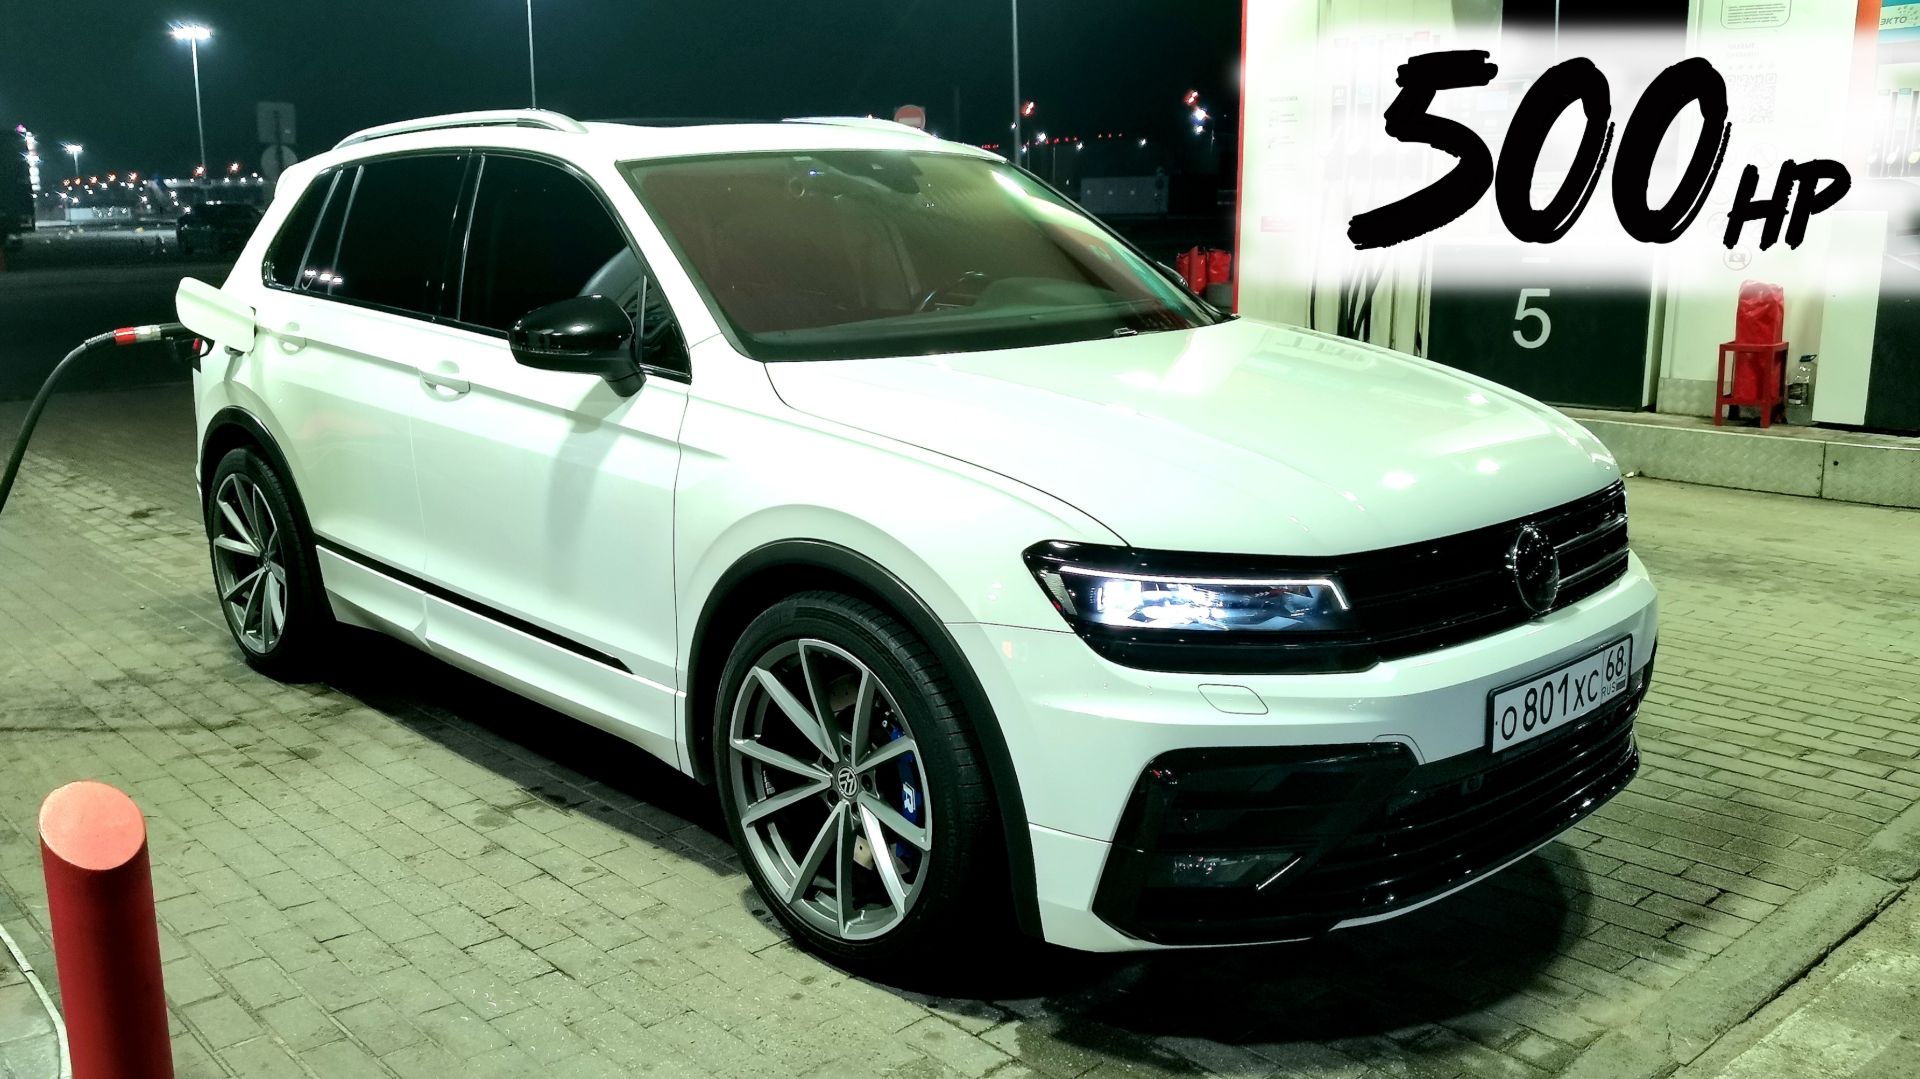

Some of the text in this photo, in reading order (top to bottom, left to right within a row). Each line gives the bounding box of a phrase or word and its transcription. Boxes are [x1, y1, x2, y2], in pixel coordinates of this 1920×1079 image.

[1512, 288, 1552, 349] 5
[1605, 645, 1625, 681] 68
[1601, 682, 1616, 696] RUS
